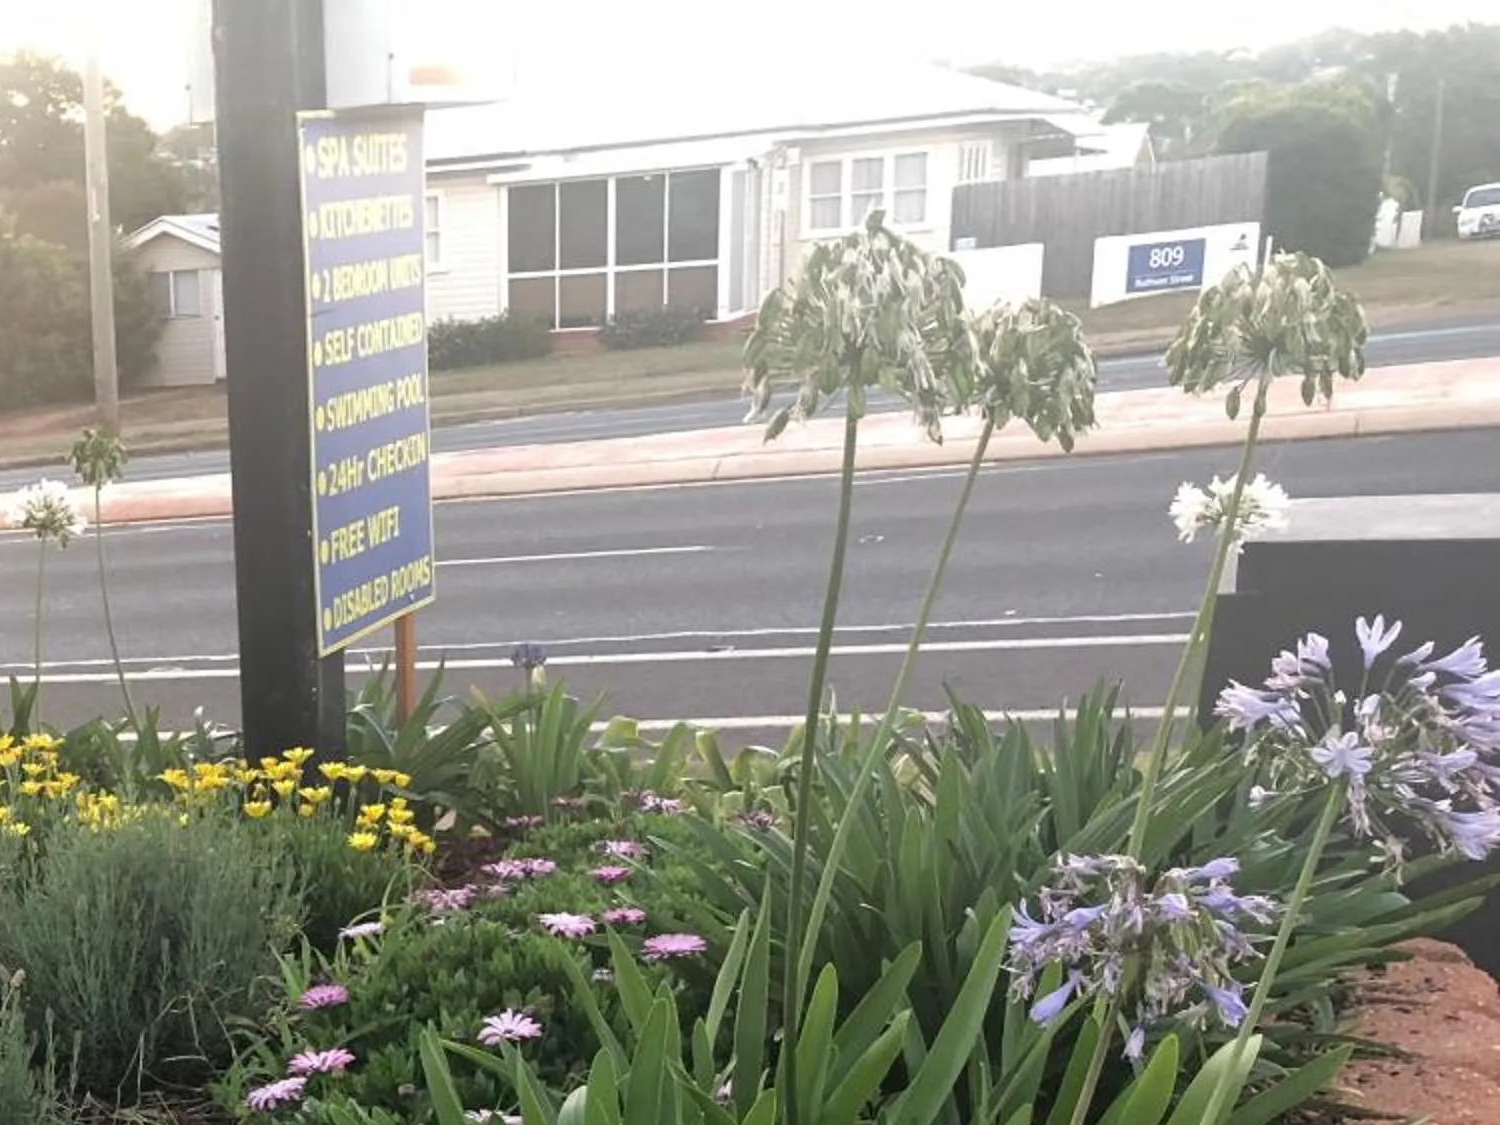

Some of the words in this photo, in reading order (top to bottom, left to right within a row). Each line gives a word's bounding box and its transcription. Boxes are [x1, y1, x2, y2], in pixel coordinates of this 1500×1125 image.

[318, 136, 350, 179] SPA
[353, 133, 407, 176] SUITES
[323, 269, 331, 302] 2
[332, 260, 389, 301] BEDROOM
[389, 254, 422, 290] UNITS
[1149, 245, 1184, 268] 809
[325, 327, 355, 365] SELF
[357, 312, 423, 358] CONTAINED
[326, 381, 395, 431] SWIMMING
[396, 373, 425, 410] POOL
[328, 455, 365, 496] 24Hr
[367, 432, 426, 481] CHECKIN
[331, 518, 365, 564] FREE
[367, 505, 400, 548] WIFI
[333, 575, 389, 628] DISABLED
[391, 554, 431, 600] ROOMS
